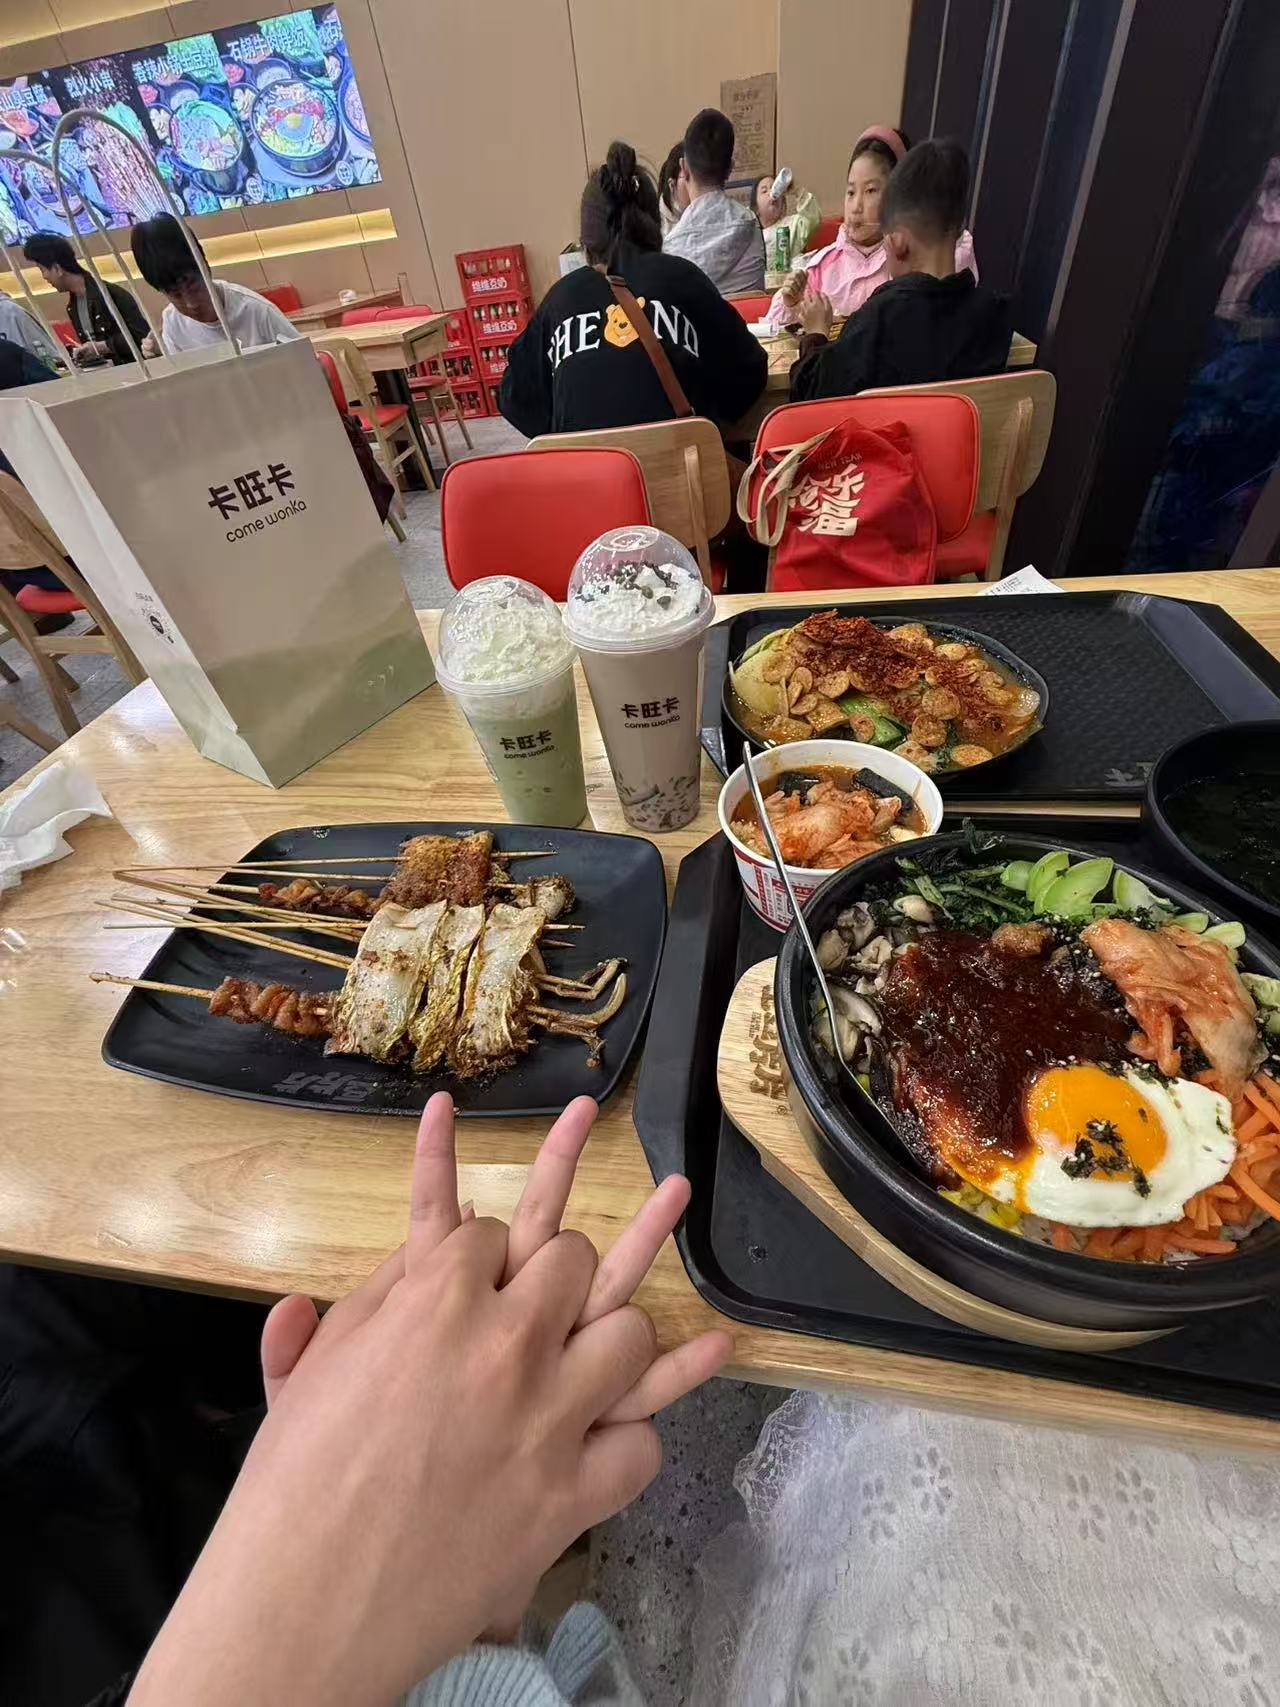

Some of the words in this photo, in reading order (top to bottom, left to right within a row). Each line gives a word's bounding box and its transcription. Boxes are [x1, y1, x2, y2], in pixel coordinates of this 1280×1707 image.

[208, 463, 296, 520] 卡旺卡
[226, 519, 265, 543] come
[621, 697, 679, 718] 卡旺卡
[499, 730, 552, 751] 卡旺卡
